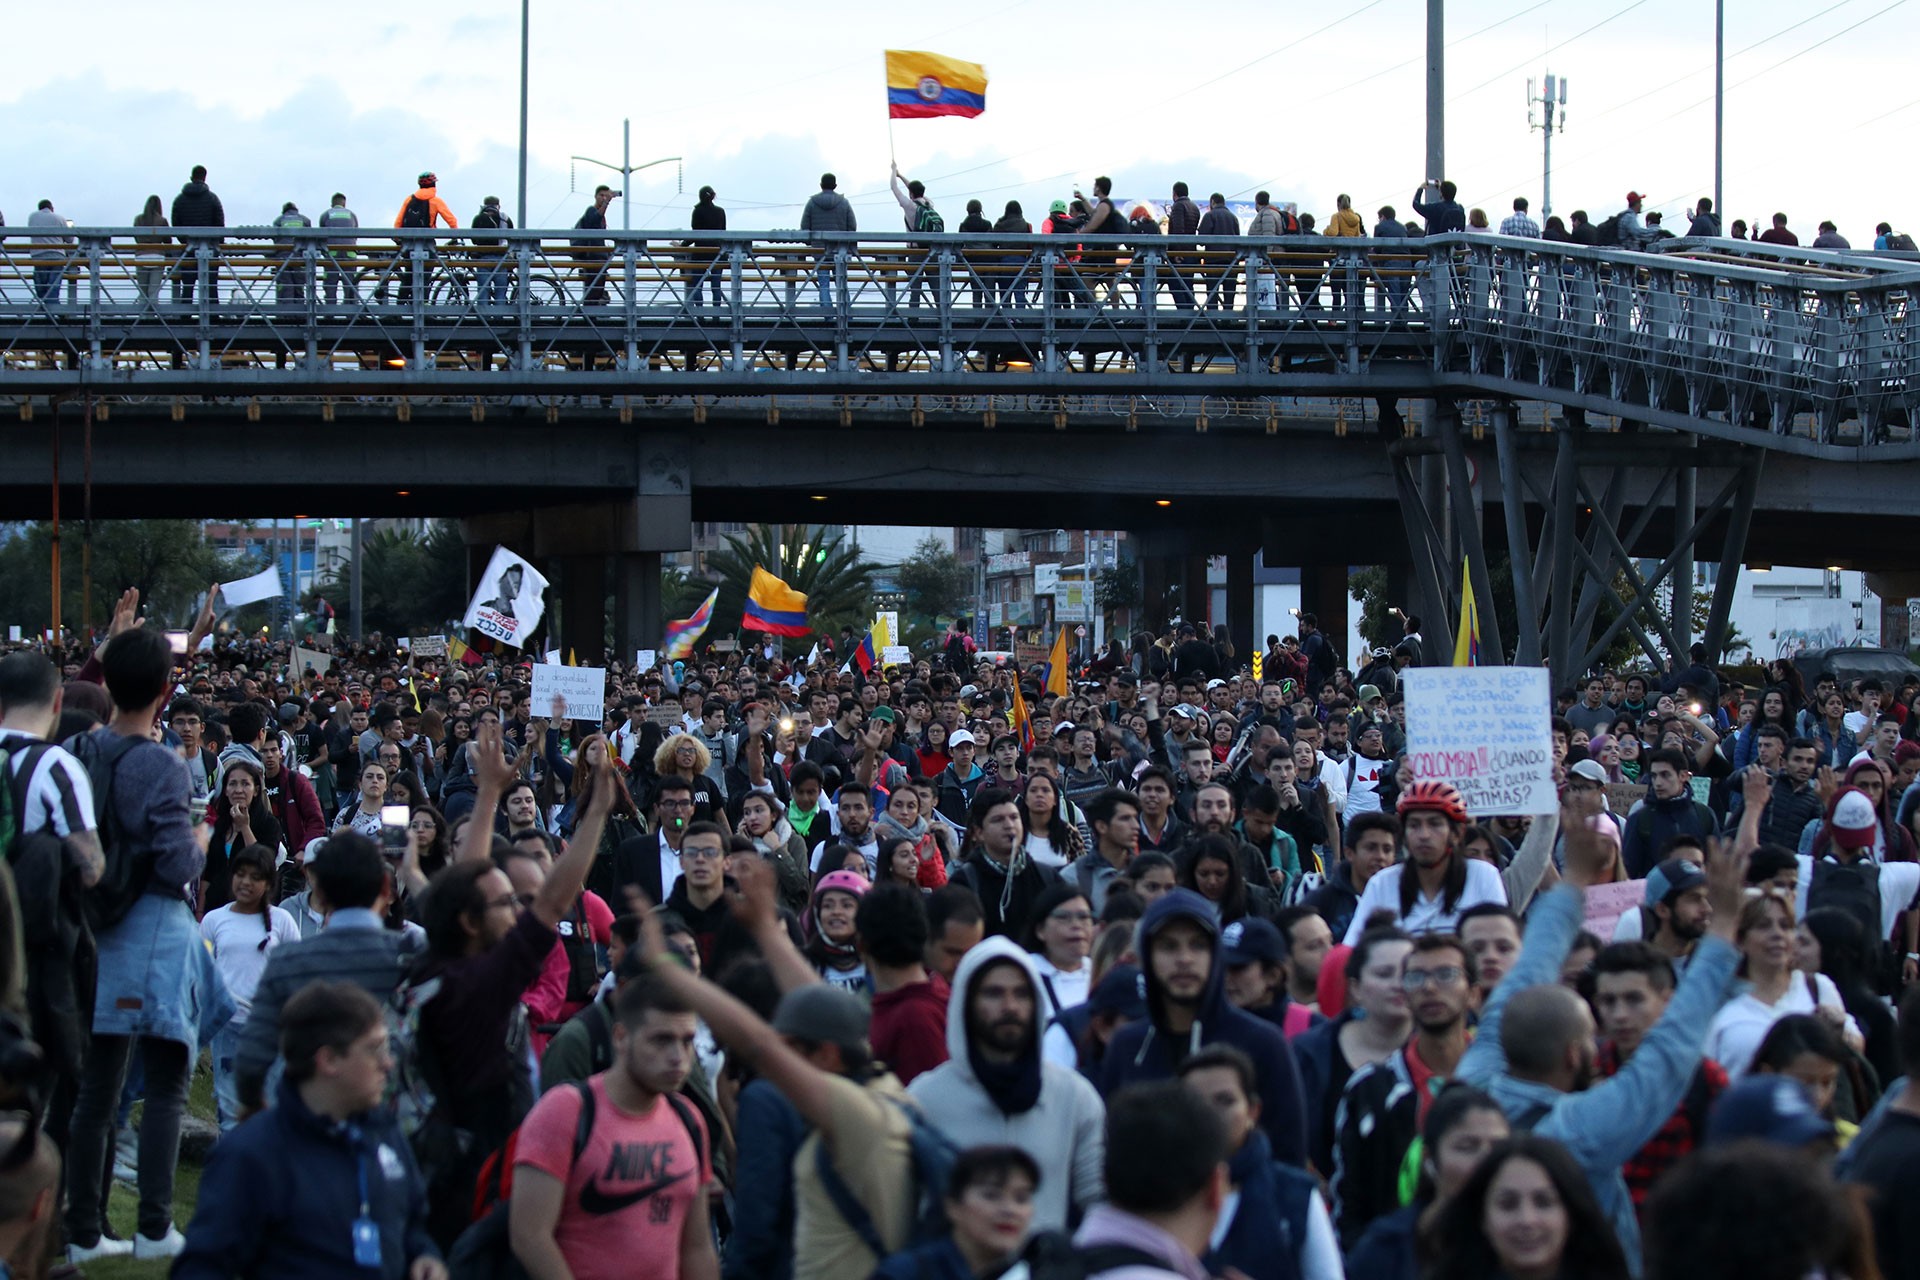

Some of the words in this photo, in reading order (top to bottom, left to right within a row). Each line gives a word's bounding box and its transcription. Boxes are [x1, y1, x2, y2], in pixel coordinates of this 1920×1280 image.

[565, 703, 601, 718] PROTESTA
[1488, 777, 1502, 790] DE
[1504, 771, 1542, 787] CULPAR
[605, 1140, 674, 1181] NIKE
